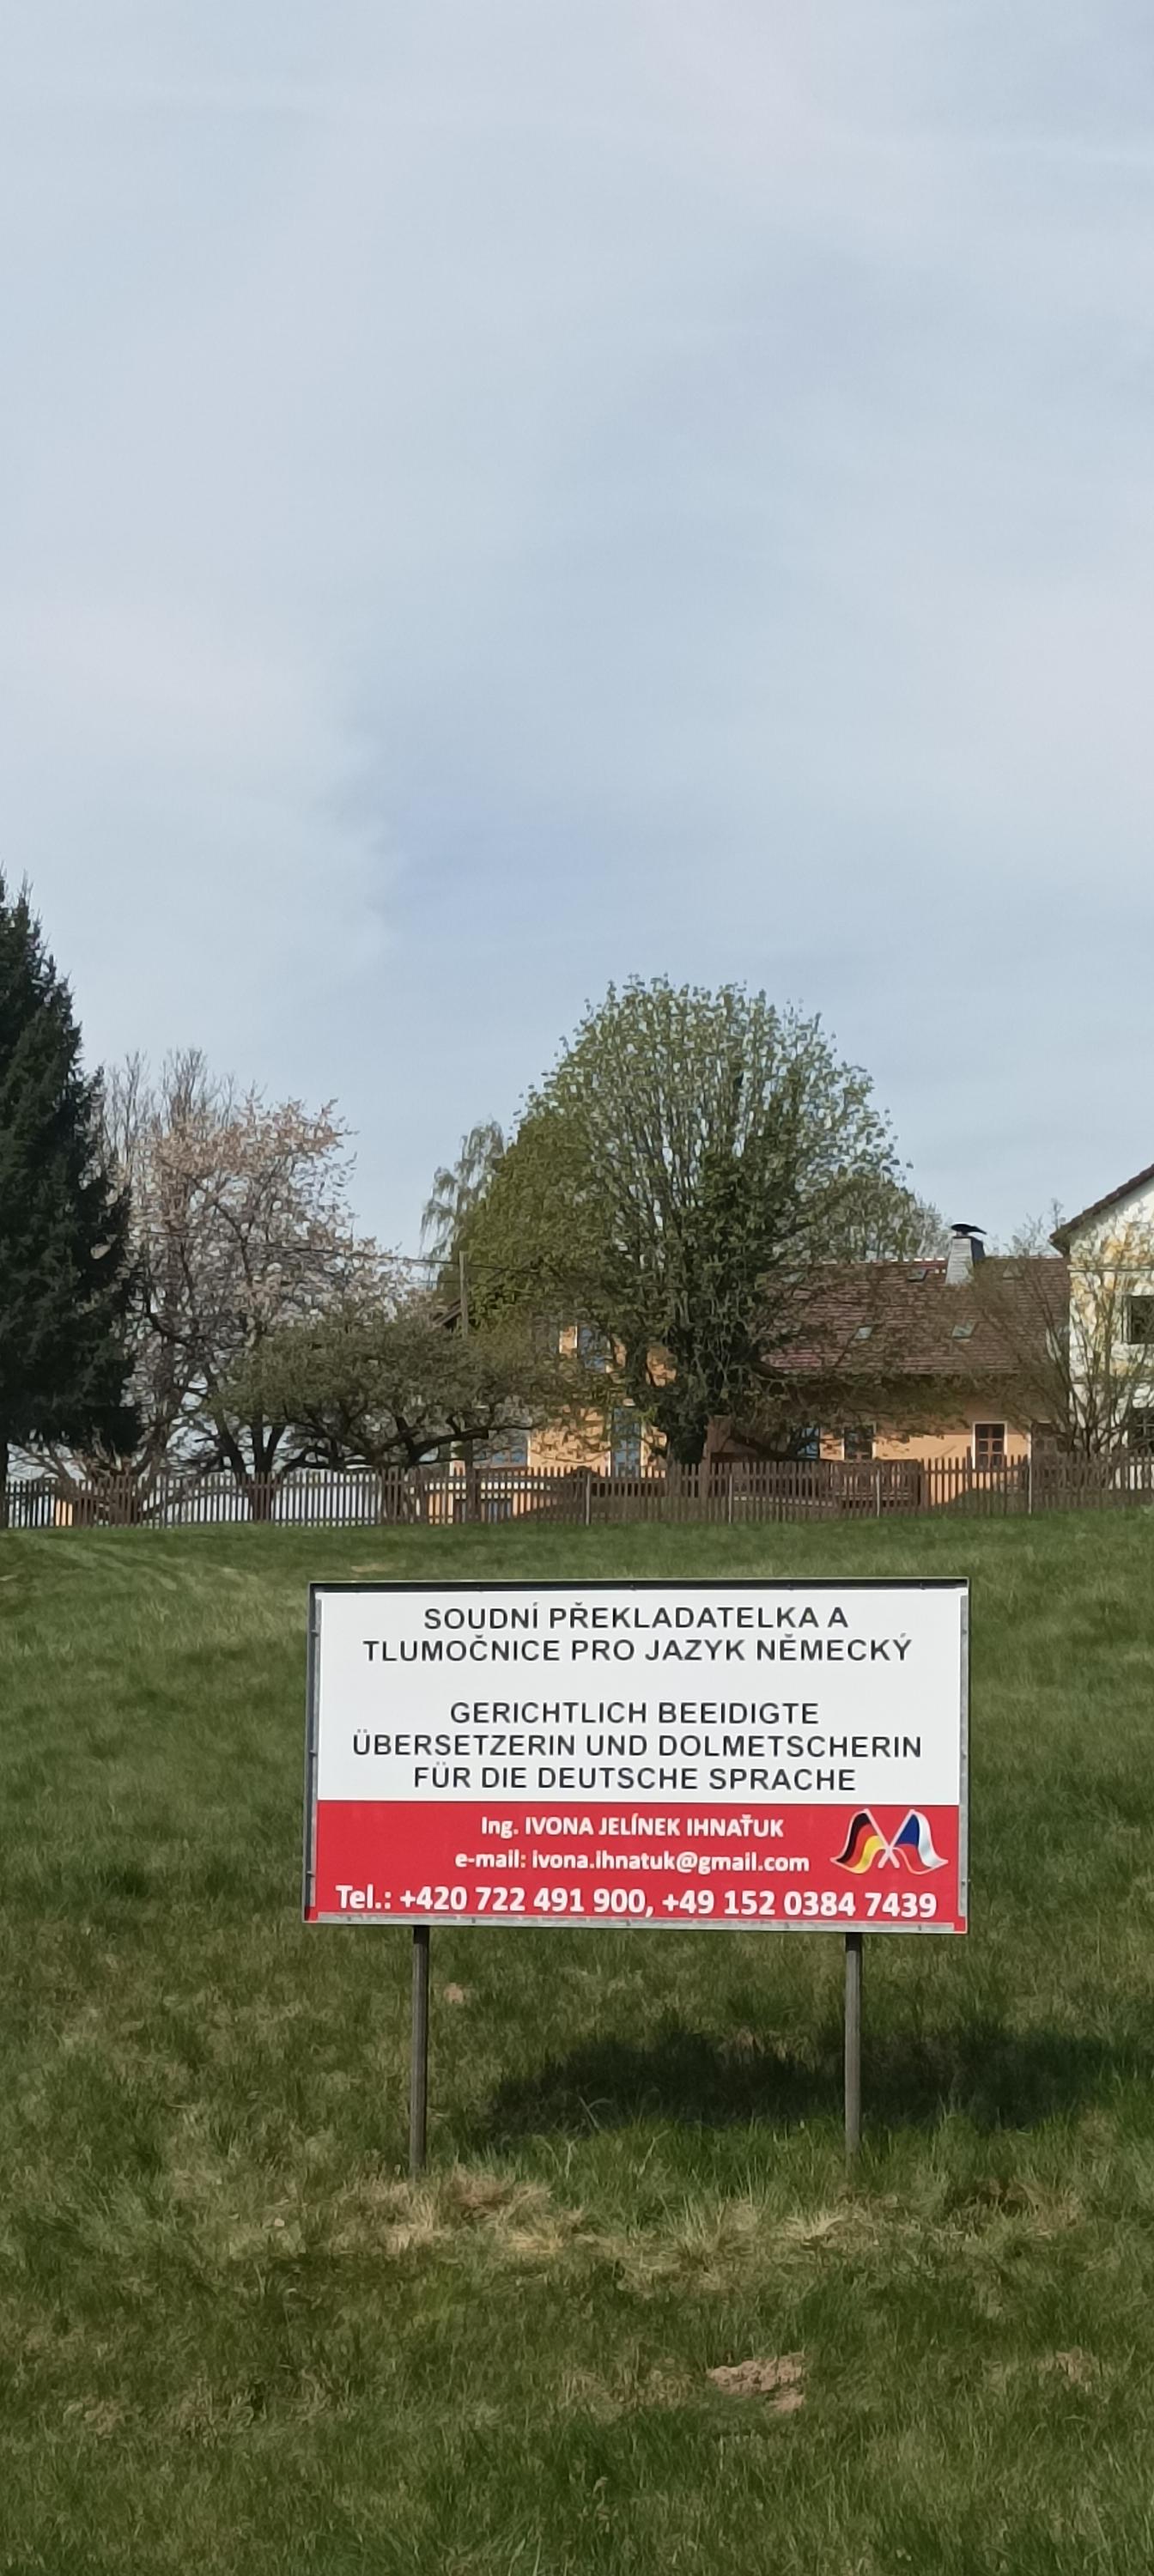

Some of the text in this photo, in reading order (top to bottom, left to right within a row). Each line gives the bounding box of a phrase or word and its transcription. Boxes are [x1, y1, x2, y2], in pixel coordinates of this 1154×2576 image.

[424, 1602, 848, 1630] SOUDNÍ PŘEKLADATELKA A
[362, 1632, 913, 1662] TLUMOČNICE PRO JAZYK NĚMECKÝ
[450, 1701, 819, 1724] GERICHTLICH BEEIDIGTE
[353, 1728, 921, 1758] ÜBERSETZERIN UND DOLMETSCHERIN
[414, 1761, 855, 1791] FÜR DIE DEUTSCHE SPRACHE
[481, 1813, 784, 1839] Ing. IVONA JELÍNEK IHNAŤUK
[455, 1849, 810, 1875] e-mail: ivona.ihnatuk@gmail.com
[336, 1884, 938, 1918] Tel.: +420 722 491 900, +49 152 0384 7439
